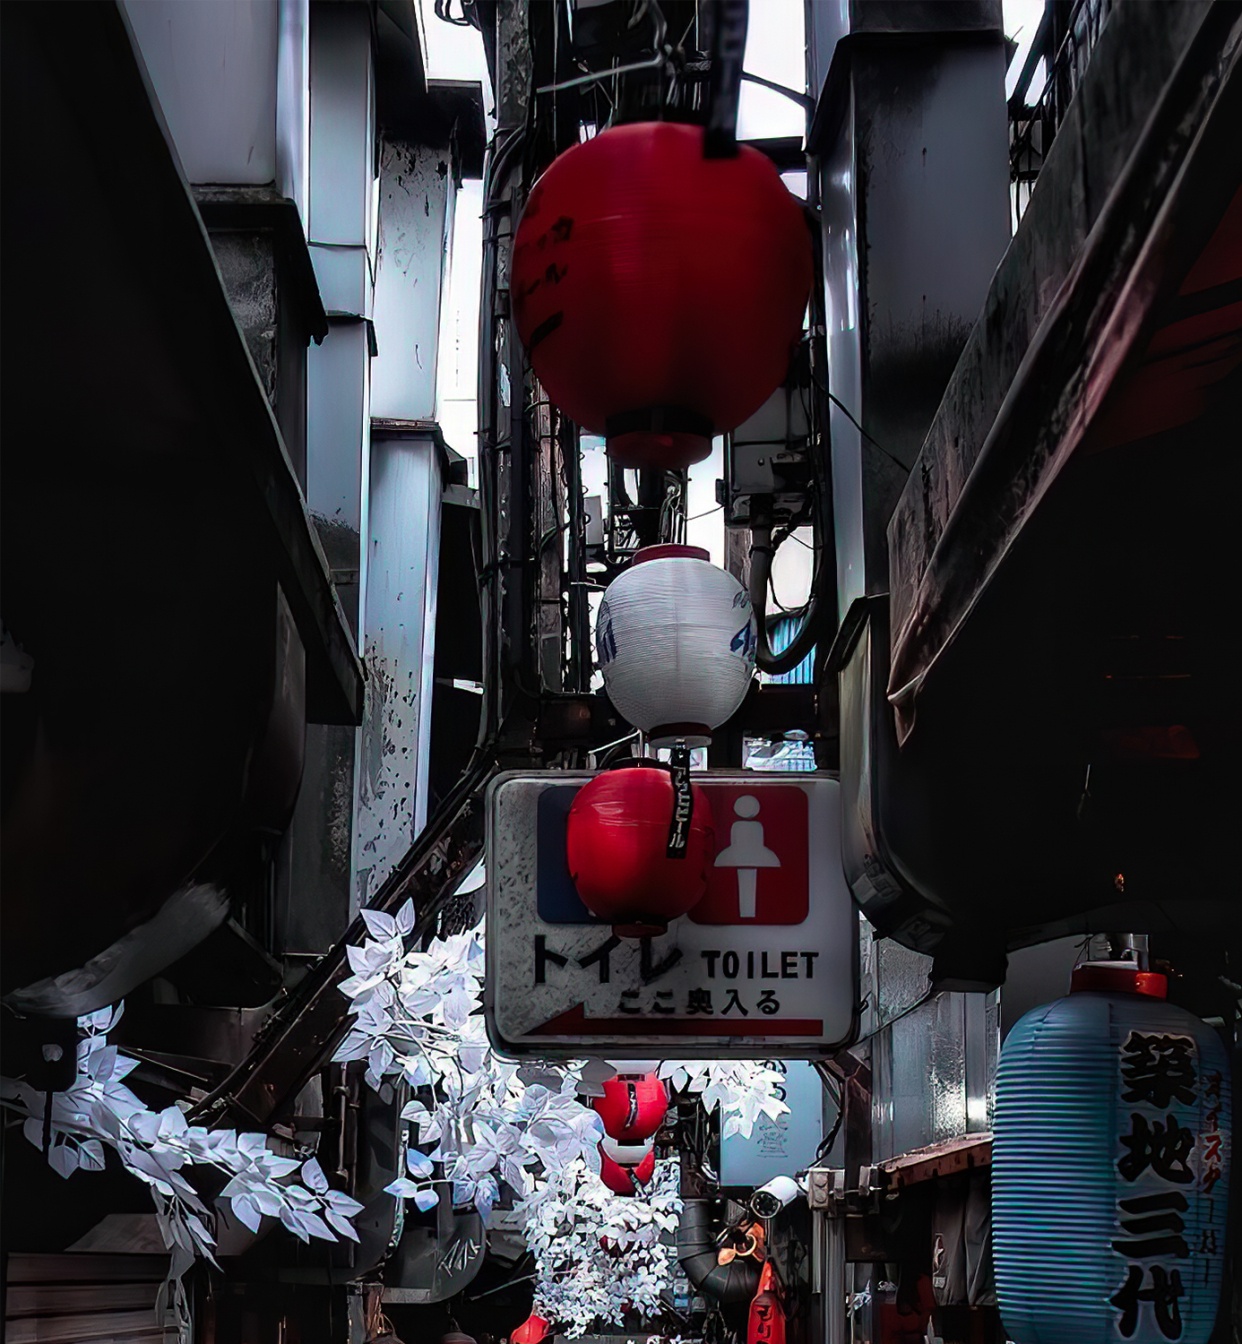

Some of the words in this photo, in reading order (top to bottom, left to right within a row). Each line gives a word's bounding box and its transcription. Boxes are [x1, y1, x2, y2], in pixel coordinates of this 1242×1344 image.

[535, 934, 683, 986] トイレ
[701, 950, 819, 979] TOILET
[617, 988, 780, 1016] ここ奥入る
[1110, 1032, 1197, 1340] 築地三代
